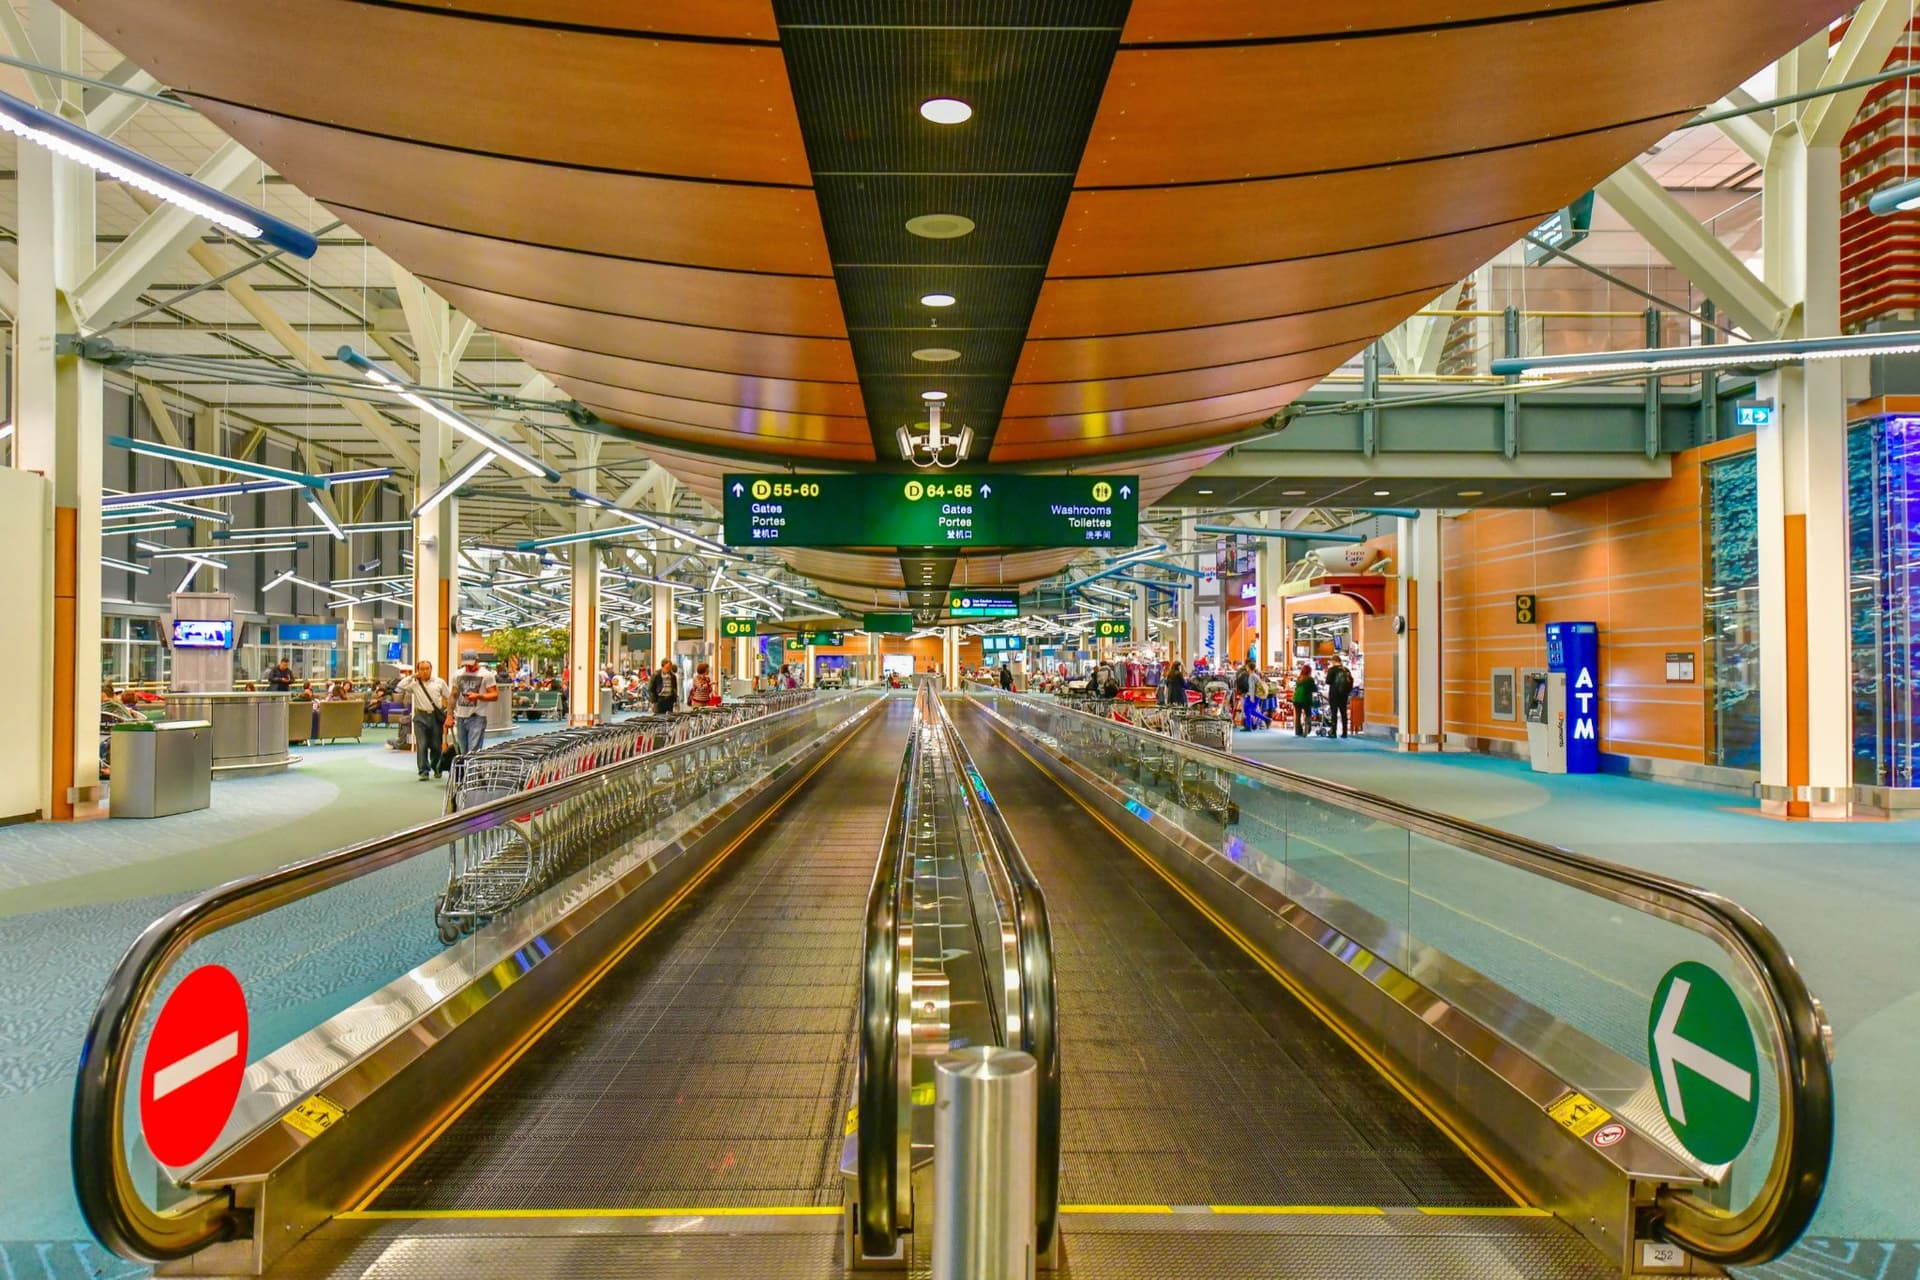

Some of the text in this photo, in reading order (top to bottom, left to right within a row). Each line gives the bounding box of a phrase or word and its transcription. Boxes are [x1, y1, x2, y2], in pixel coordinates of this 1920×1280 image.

[773, 483, 820, 497] 55-60
[926, 484, 973, 498] 64-65
[751, 503, 783, 514] Gates
[942, 504, 973, 514] Gates
[1051, 505, 1112, 515] Washrooms
[752, 516, 786, 526] Portes
[938, 517, 972, 527] Portes
[1068, 518, 1112, 528] Toilettes
[1573, 666, 1595, 739] ATM
[1654, 1249, 1674, 1261] 252
